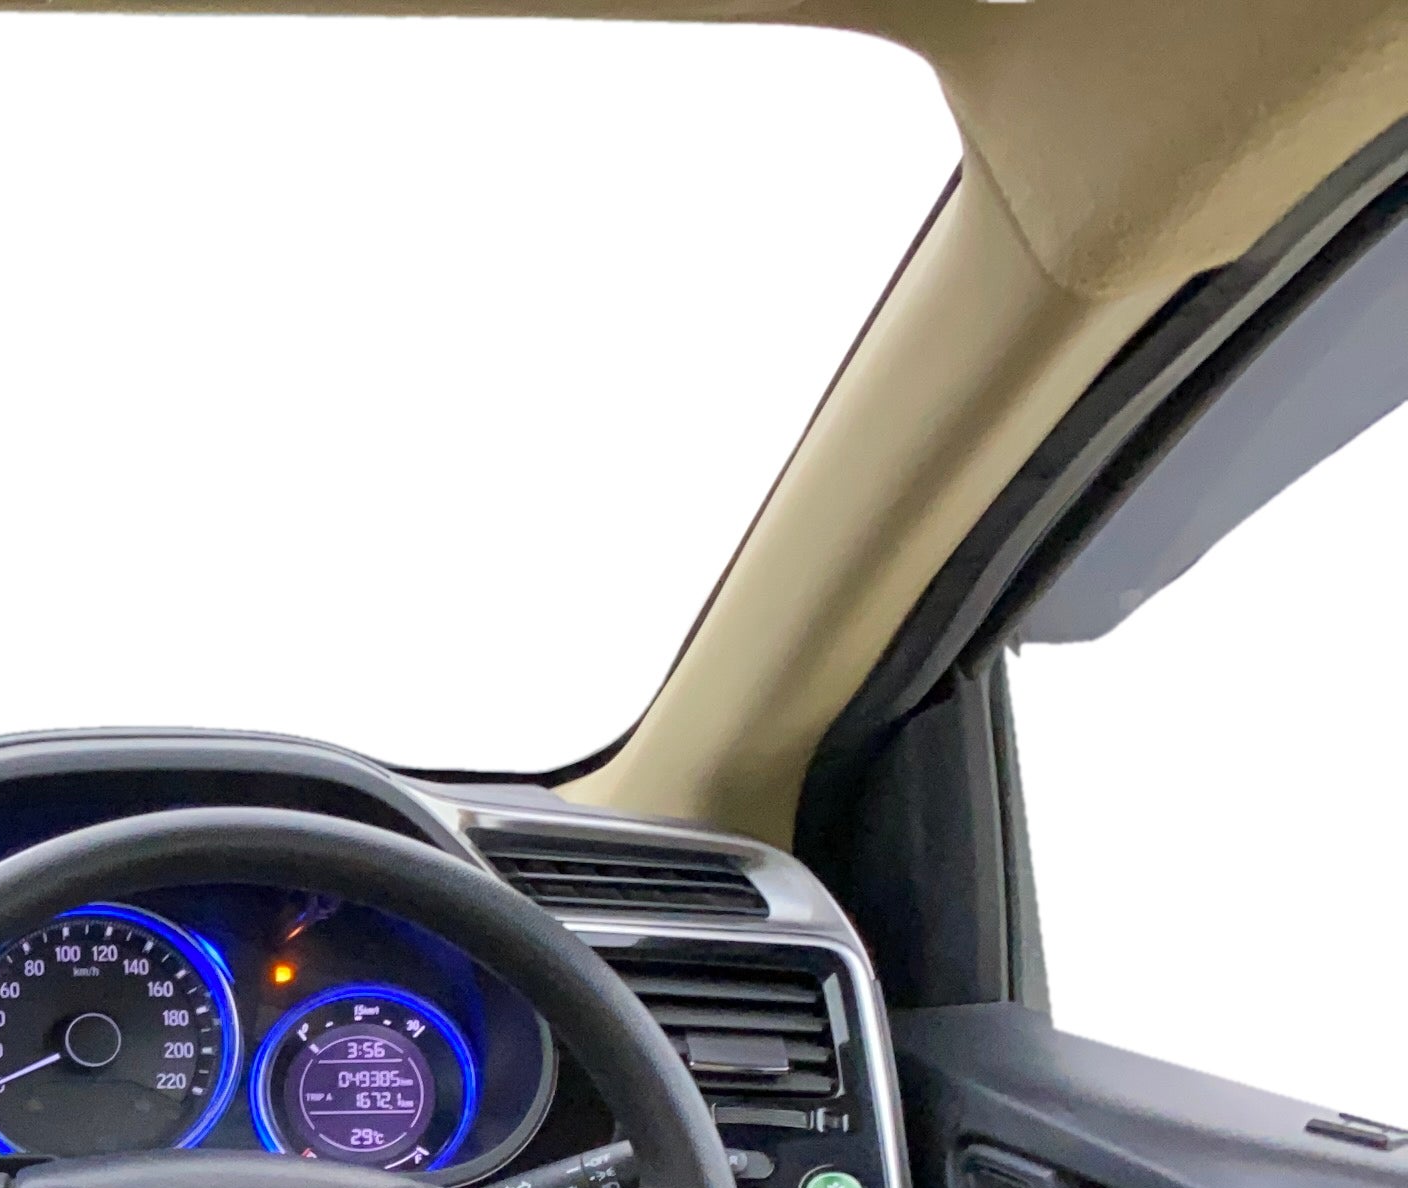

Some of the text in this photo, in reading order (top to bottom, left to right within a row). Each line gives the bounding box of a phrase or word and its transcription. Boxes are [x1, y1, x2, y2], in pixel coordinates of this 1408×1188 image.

[55, 946, 81, 962] 100
[92, 945, 118, 961] 120
[24, 960, 45, 976] 80
[73, 967, 100, 977] km/h
[123, 959, 149, 975] 140
[0, 982, 20, 998] 60
[147, 981, 174, 997] 160
[162, 1010, 190, 1026] 180
[406, 1019, 420, 1031] 30
[164, 1042, 194, 1058] 200
[347, 1042, 385, 1058] 3:56
[156, 1073, 187, 1089] 220
